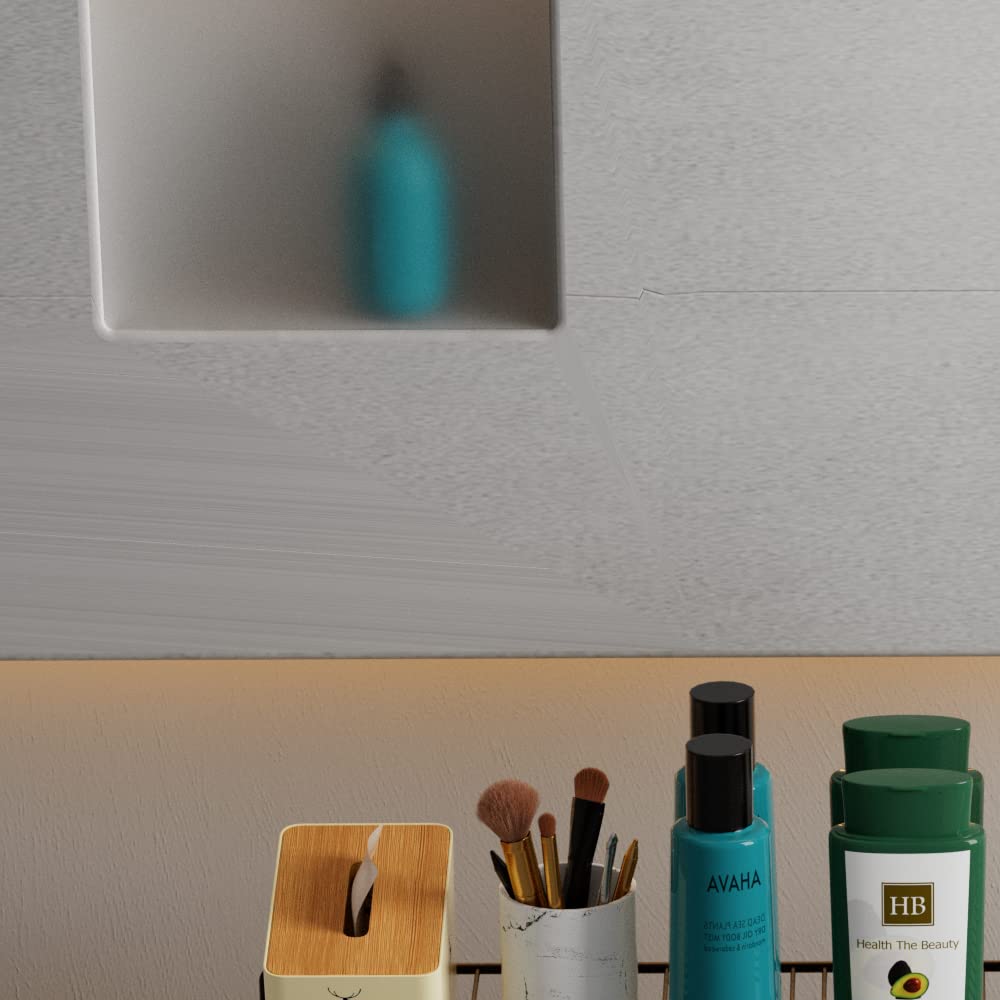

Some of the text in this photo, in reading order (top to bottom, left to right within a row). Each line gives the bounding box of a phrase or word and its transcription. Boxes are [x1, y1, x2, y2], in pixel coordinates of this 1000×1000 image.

[889, 896, 927, 916] HB
[856, 938, 960, 951] Health The Beauty
